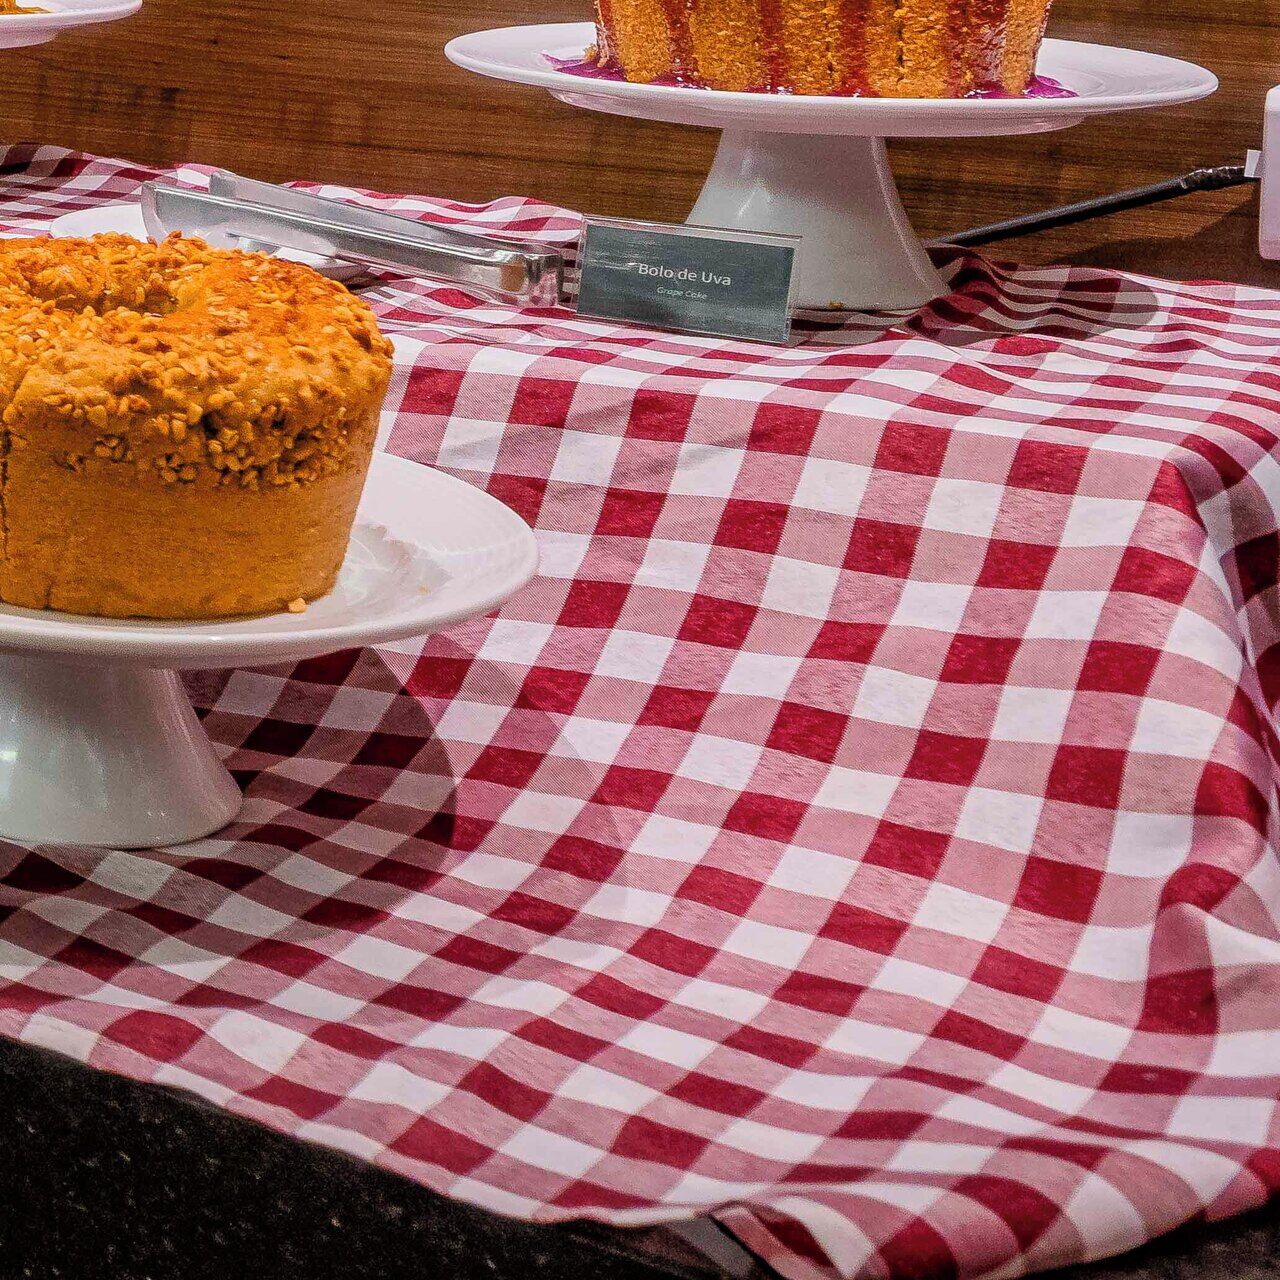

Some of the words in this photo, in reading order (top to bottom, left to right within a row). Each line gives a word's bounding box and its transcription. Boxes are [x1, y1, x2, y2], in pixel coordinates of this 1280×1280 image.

[638, 263, 673, 279] Bolo
[677, 269, 697, 282] de
[701, 272, 732, 286] Uva
[656, 286, 684, 298] Grape
[685, 290, 708, 300] Cake
